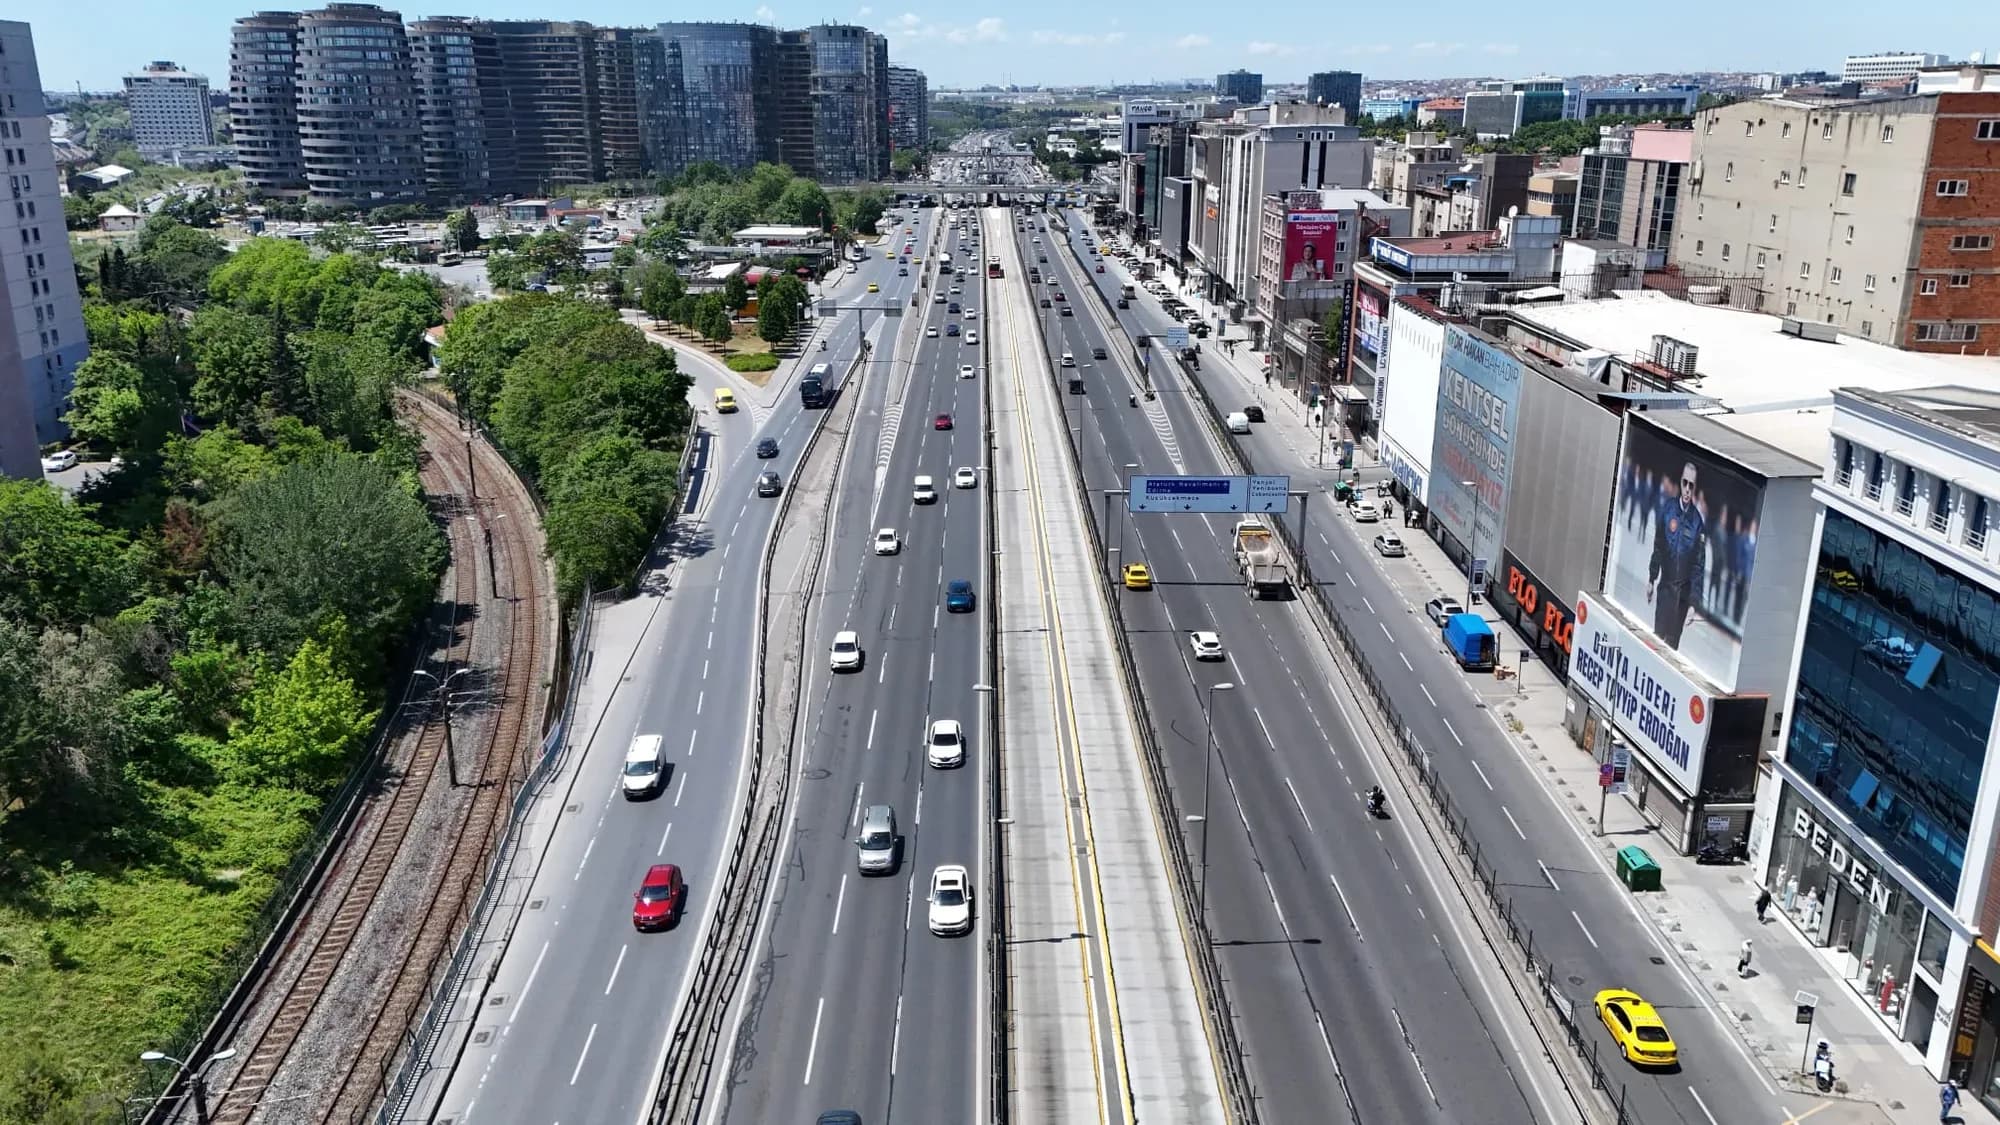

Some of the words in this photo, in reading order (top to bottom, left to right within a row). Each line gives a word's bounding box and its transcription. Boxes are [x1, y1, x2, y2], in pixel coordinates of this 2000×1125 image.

[1463, 340, 1485, 366] HAKAN
[1443, 365, 1509, 441] KENTSEL
[1508, 566, 1537, 614] FLO
[1543, 601, 1573, 654] FLO
[1594, 631, 1629, 682] DÜNYA
[1576, 647, 1604, 690] RECEP
[1638, 706, 1691, 772] ERDOĞAN
[1794, 807, 1892, 916] BEDEN
[1959, 970, 1986, 1036] istikbal
